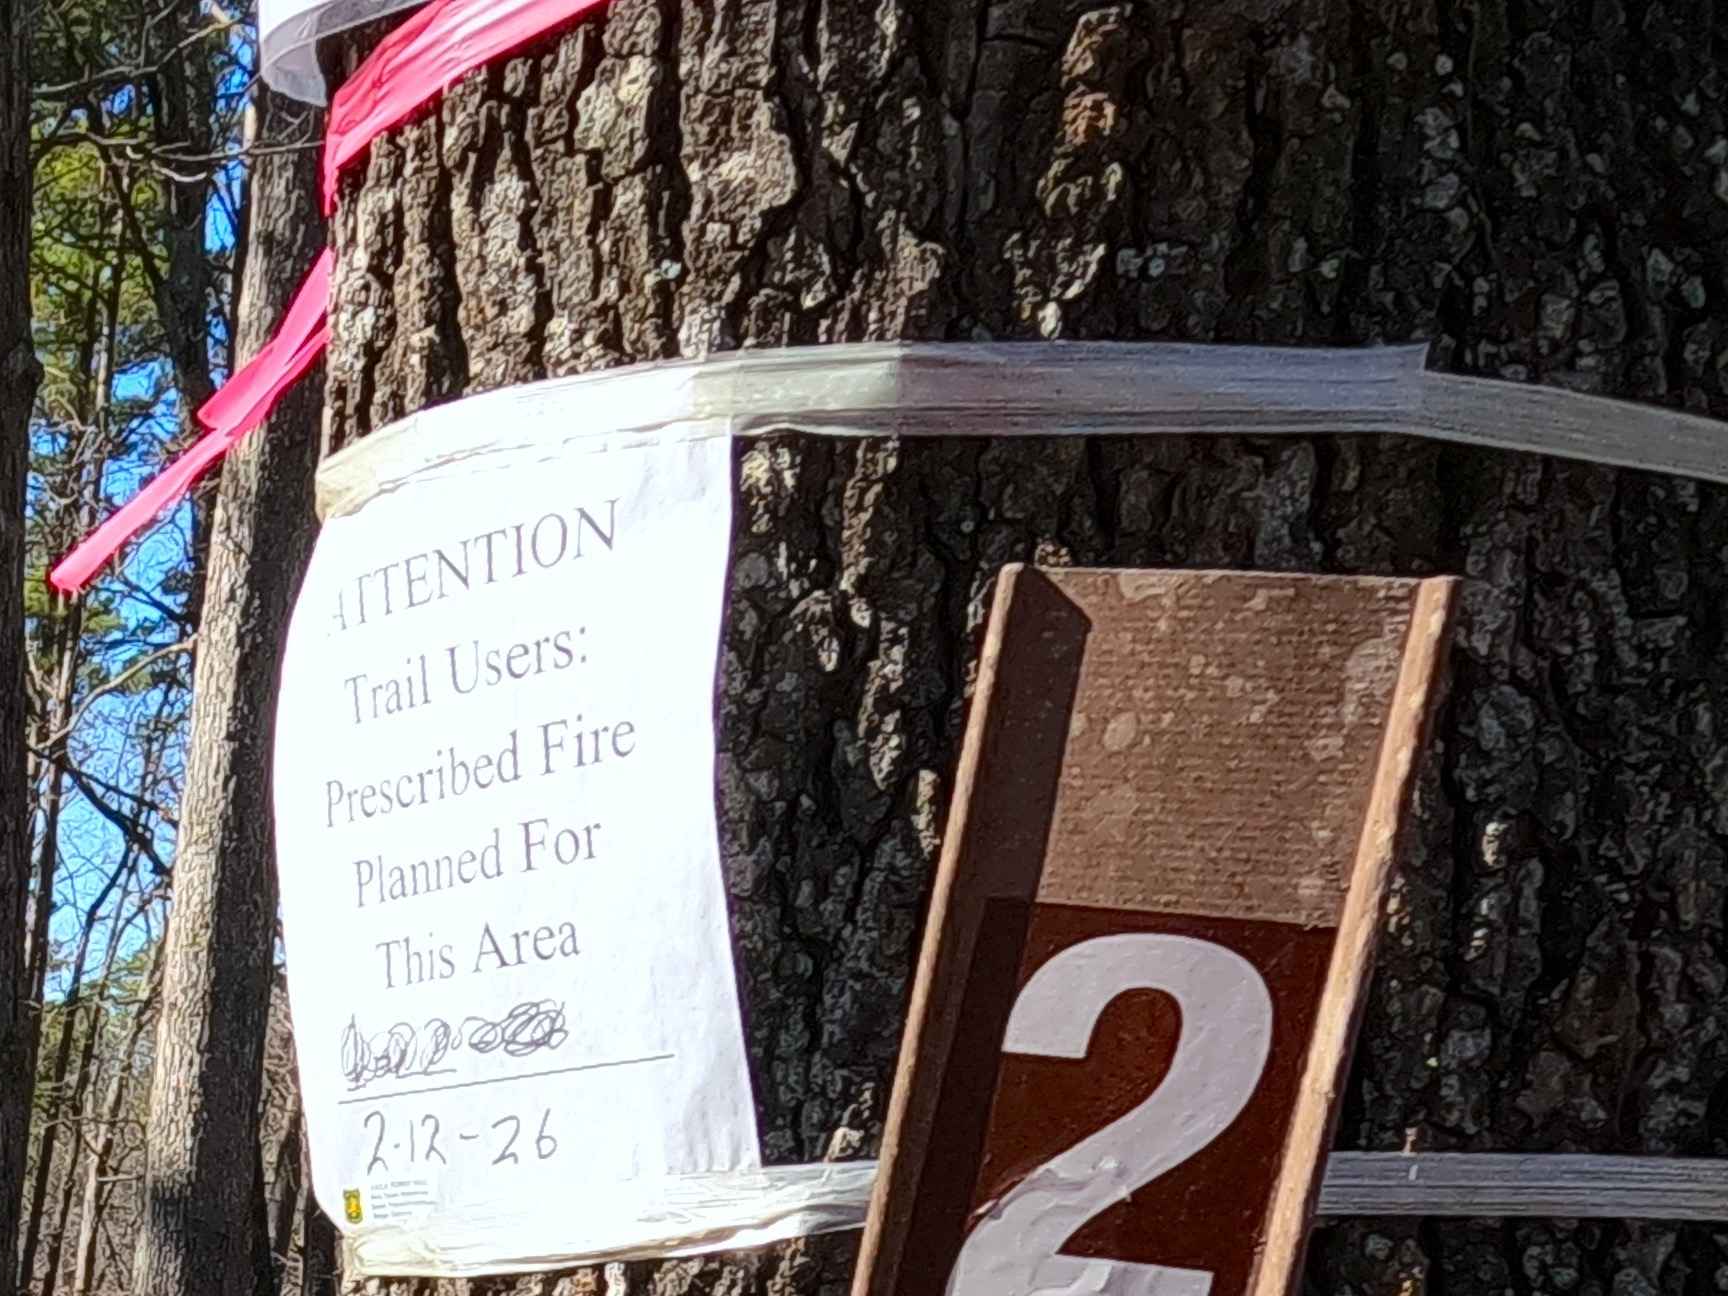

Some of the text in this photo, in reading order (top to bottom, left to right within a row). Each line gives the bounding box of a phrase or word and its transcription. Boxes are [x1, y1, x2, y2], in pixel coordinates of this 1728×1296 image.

[344, 626, 587, 724] Trail Users:
[326, 714, 636, 828] Prescribed Fire
[353, 818, 602, 908] Planned For
[376, 921, 580, 989] This Area
